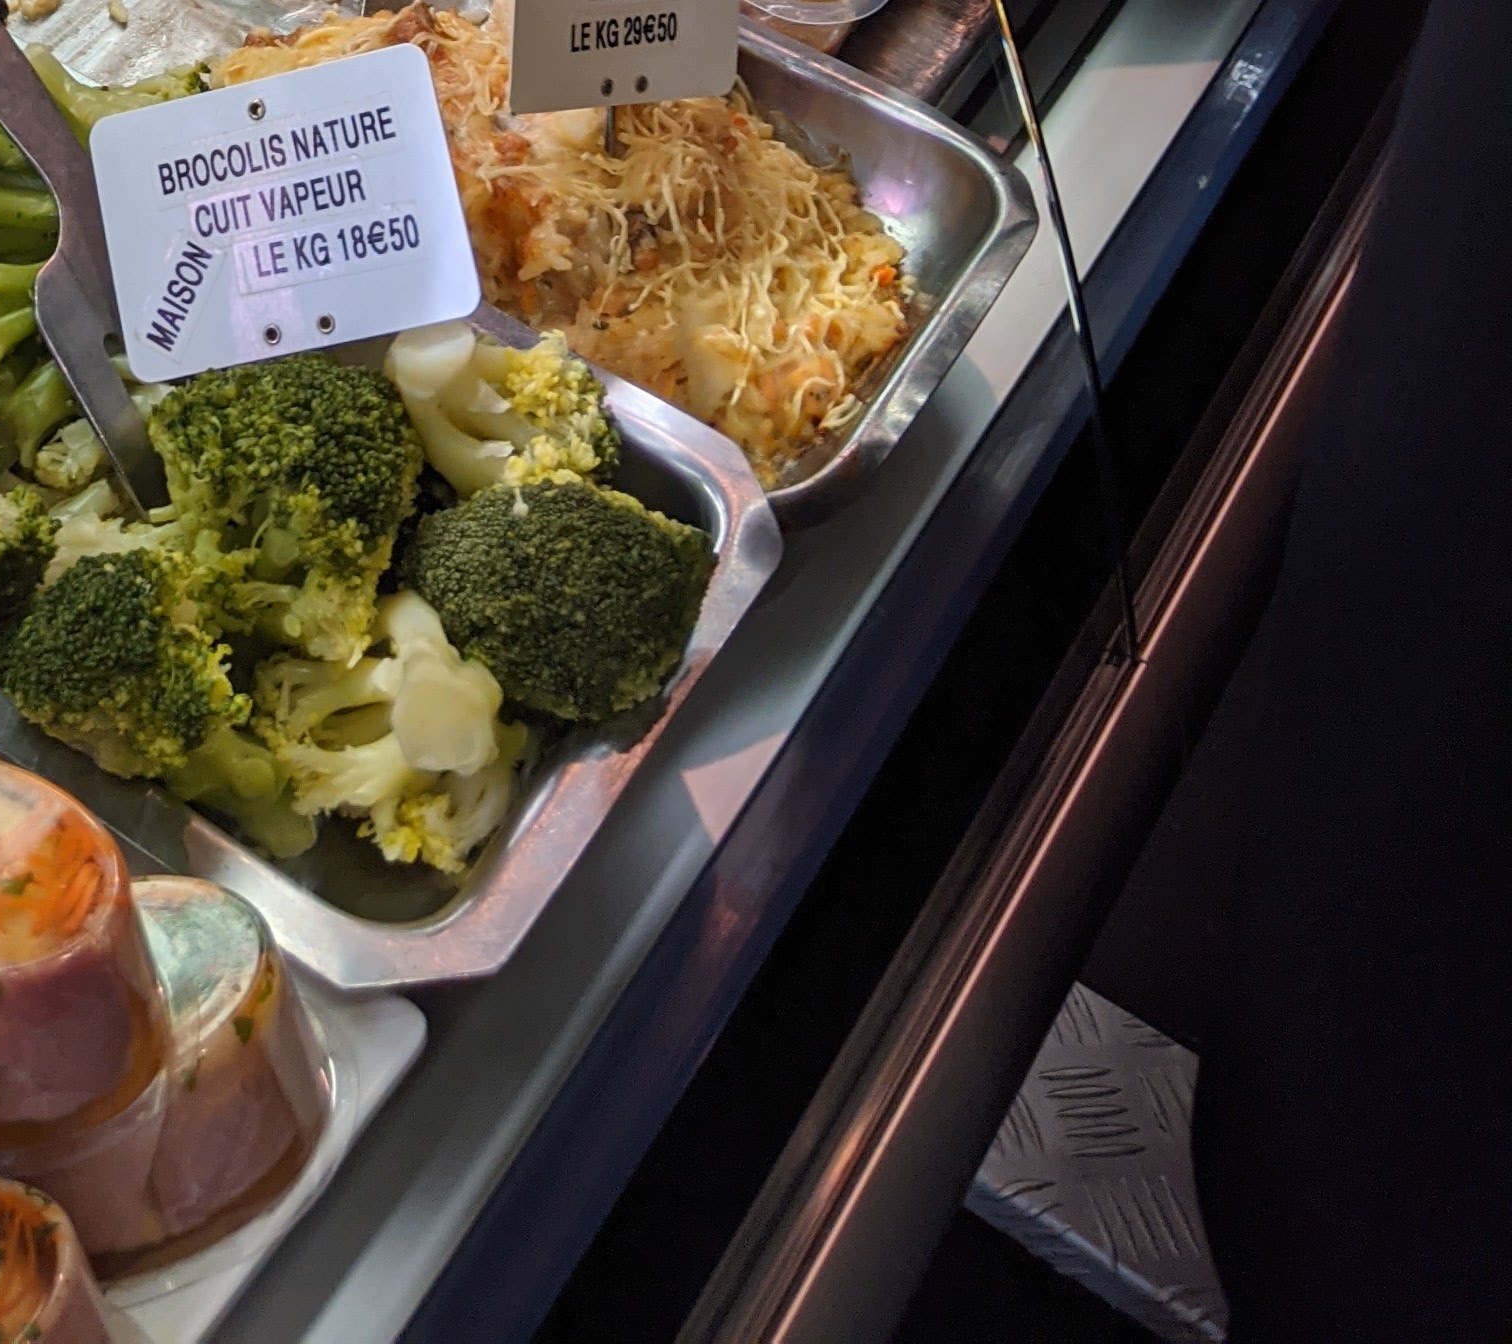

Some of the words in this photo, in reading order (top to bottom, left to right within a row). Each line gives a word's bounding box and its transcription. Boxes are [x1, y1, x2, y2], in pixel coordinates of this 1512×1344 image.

[570, 23, 591, 53] LE
[596, 18, 619, 50] KG
[623, 12, 678, 46] 29€50
[158, 133, 286, 196] BROCOLIS
[292, 106, 396, 161] NATURE
[195, 194, 253, 238] CUIT
[259, 169, 367, 222] VAPEUR
[254, 241, 288, 278] LE
[295, 234, 330, 270] KG
[337, 214, 420, 261] 18€50
[146, 241, 213, 352] MAISON
